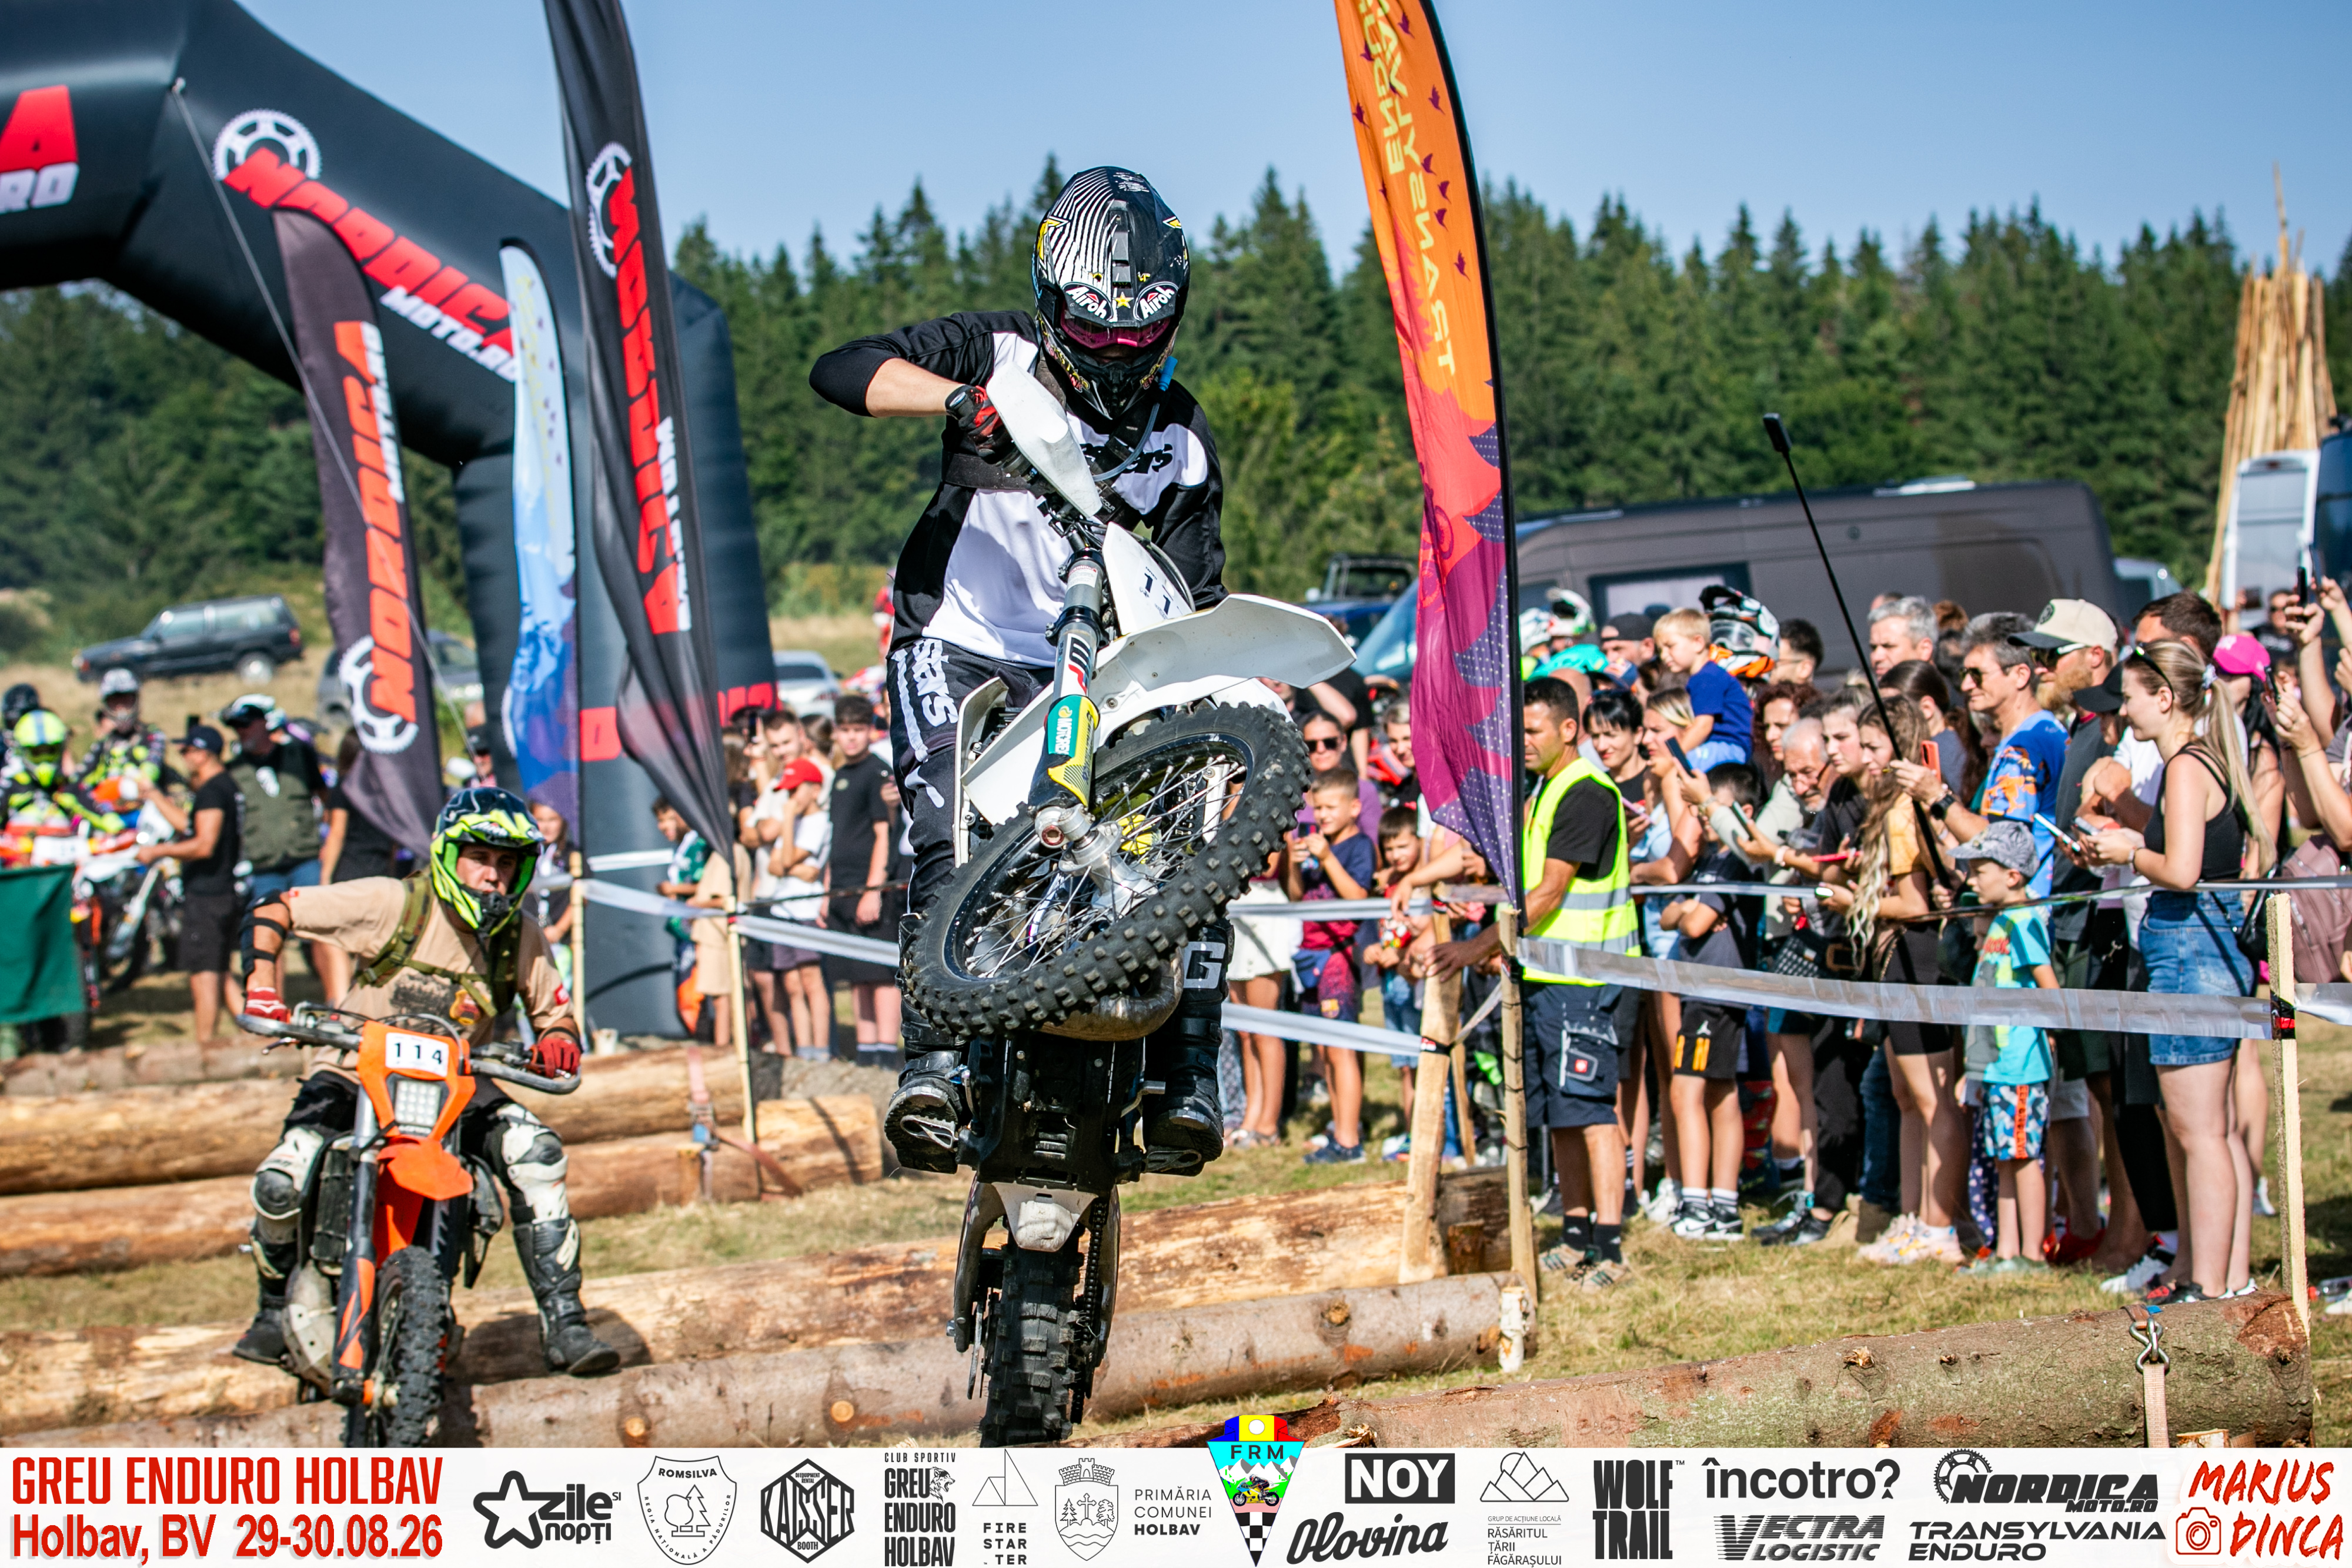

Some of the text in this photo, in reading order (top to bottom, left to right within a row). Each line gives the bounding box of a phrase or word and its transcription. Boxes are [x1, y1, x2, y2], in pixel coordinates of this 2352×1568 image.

[1065, 286, 1108, 320] Airoh
[1139, 286, 1175, 320] Airoh
[333, 320, 417, 722] NORDICA
[395, 1042, 442, 1065] 114
